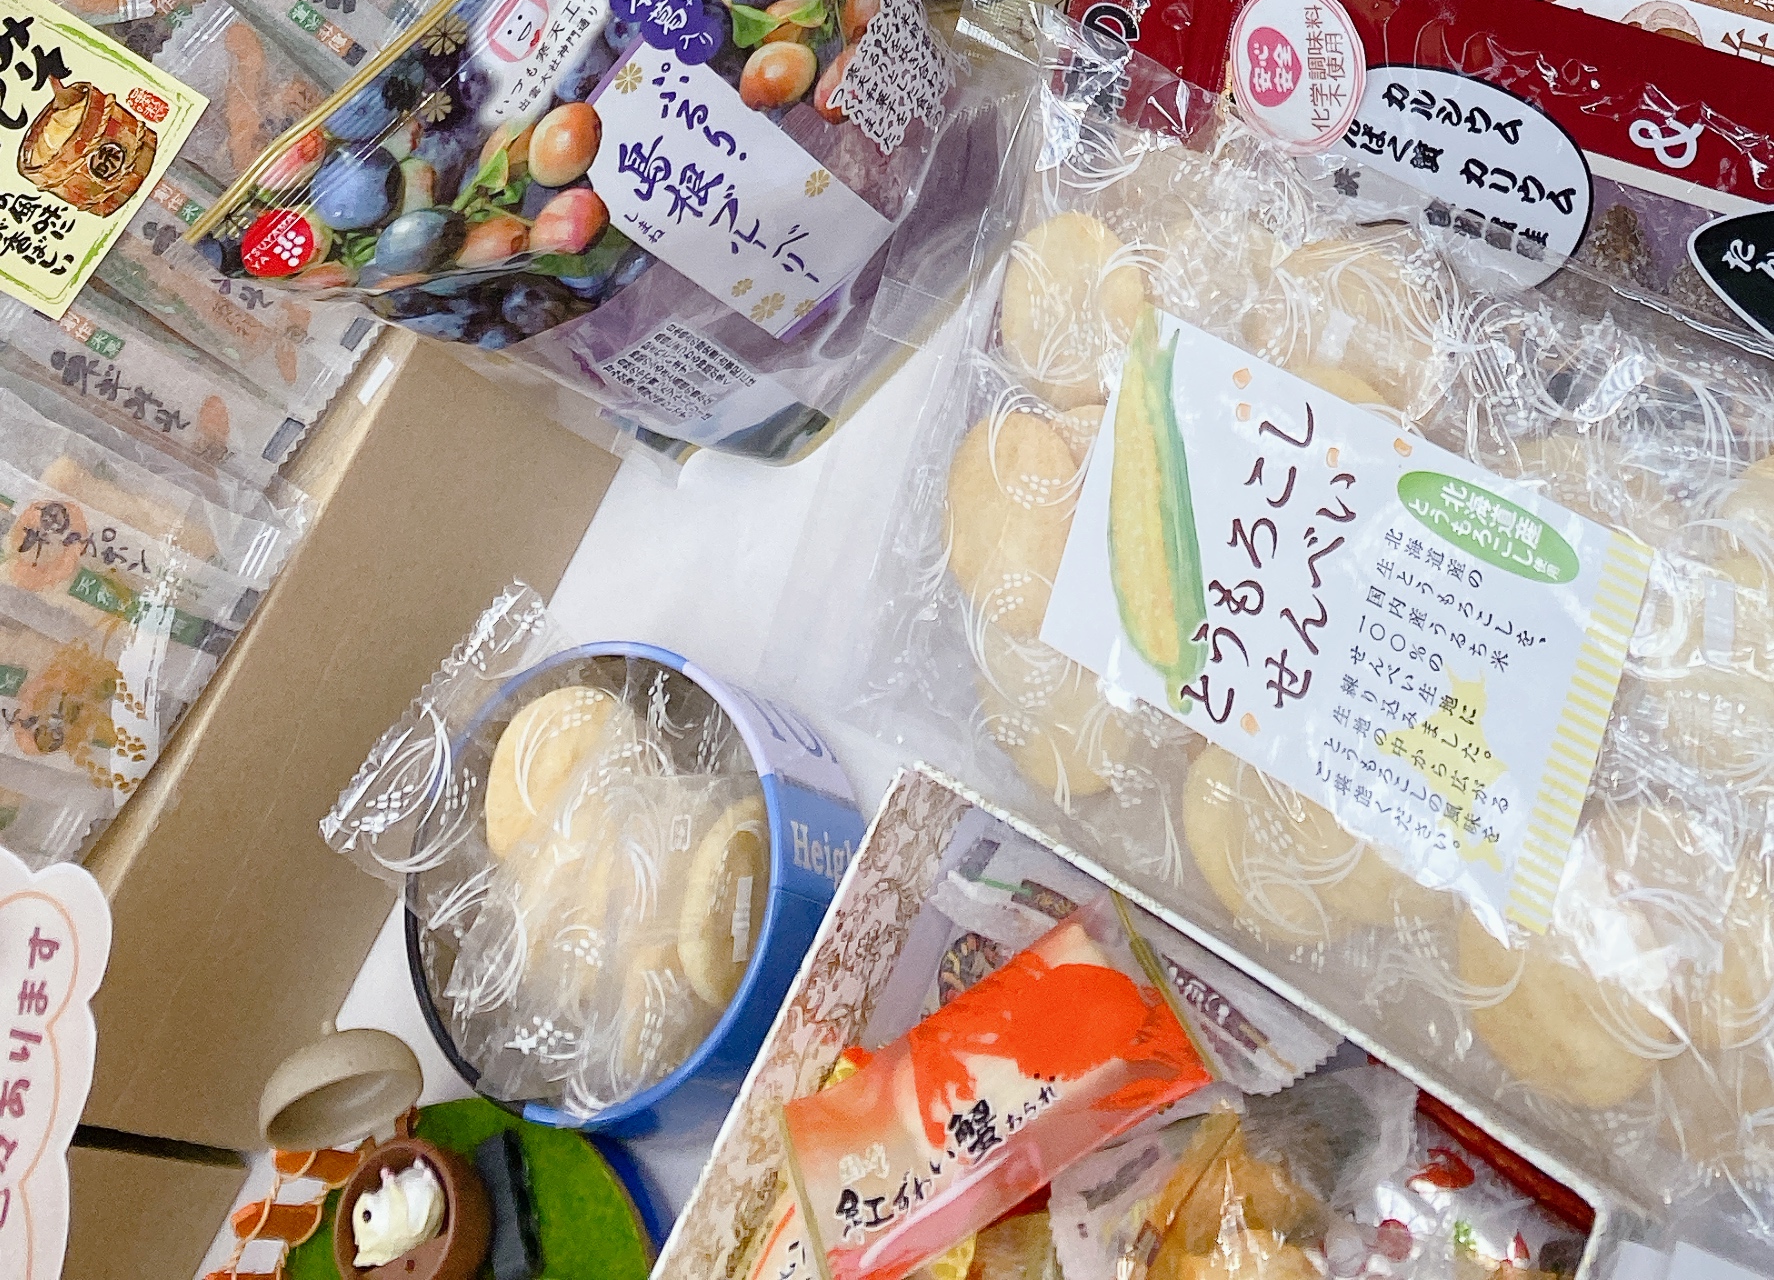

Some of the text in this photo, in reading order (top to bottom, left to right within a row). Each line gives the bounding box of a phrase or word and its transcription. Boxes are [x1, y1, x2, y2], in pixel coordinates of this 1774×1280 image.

[516, 4, 599, 115] 出雲大社神門通り
[1252, 41, 1274, 94] 安心
[1273, 42, 1296, 94] 安全
[1303, 4, 1331, 133] 化学調味料
[1324, 31, 1348, 109] 不使用
[1381, 81, 1524, 146] カルシウム
[618, 135, 821, 285] 島根ブルーベリー
[1458, 157, 1578, 216] カリウム
[244, 210, 298, 262] TSUYAMA
[253, 253, 272, 271] YA
[623, 212, 667, 245] しまね
[1440, 482, 1544, 551] 北海道産
[1179, 402, 1317, 725] とうもろこし
[1264, 471, 1358, 710] せんべい
[1385, 526, 1485, 590] 北海道産の
[1365, 585, 1510, 674] 国内産うるち米
[1375, 558, 1550, 647] 生とうもろこしを、
[1340, 673, 1494, 763] 練り込みました。
[1349, 645, 1479, 727] せんべい生地に
[1323, 735, 1501, 845] とうもろこしの風味を
[1331, 704, 1511, 815] 生地の中から広がる
